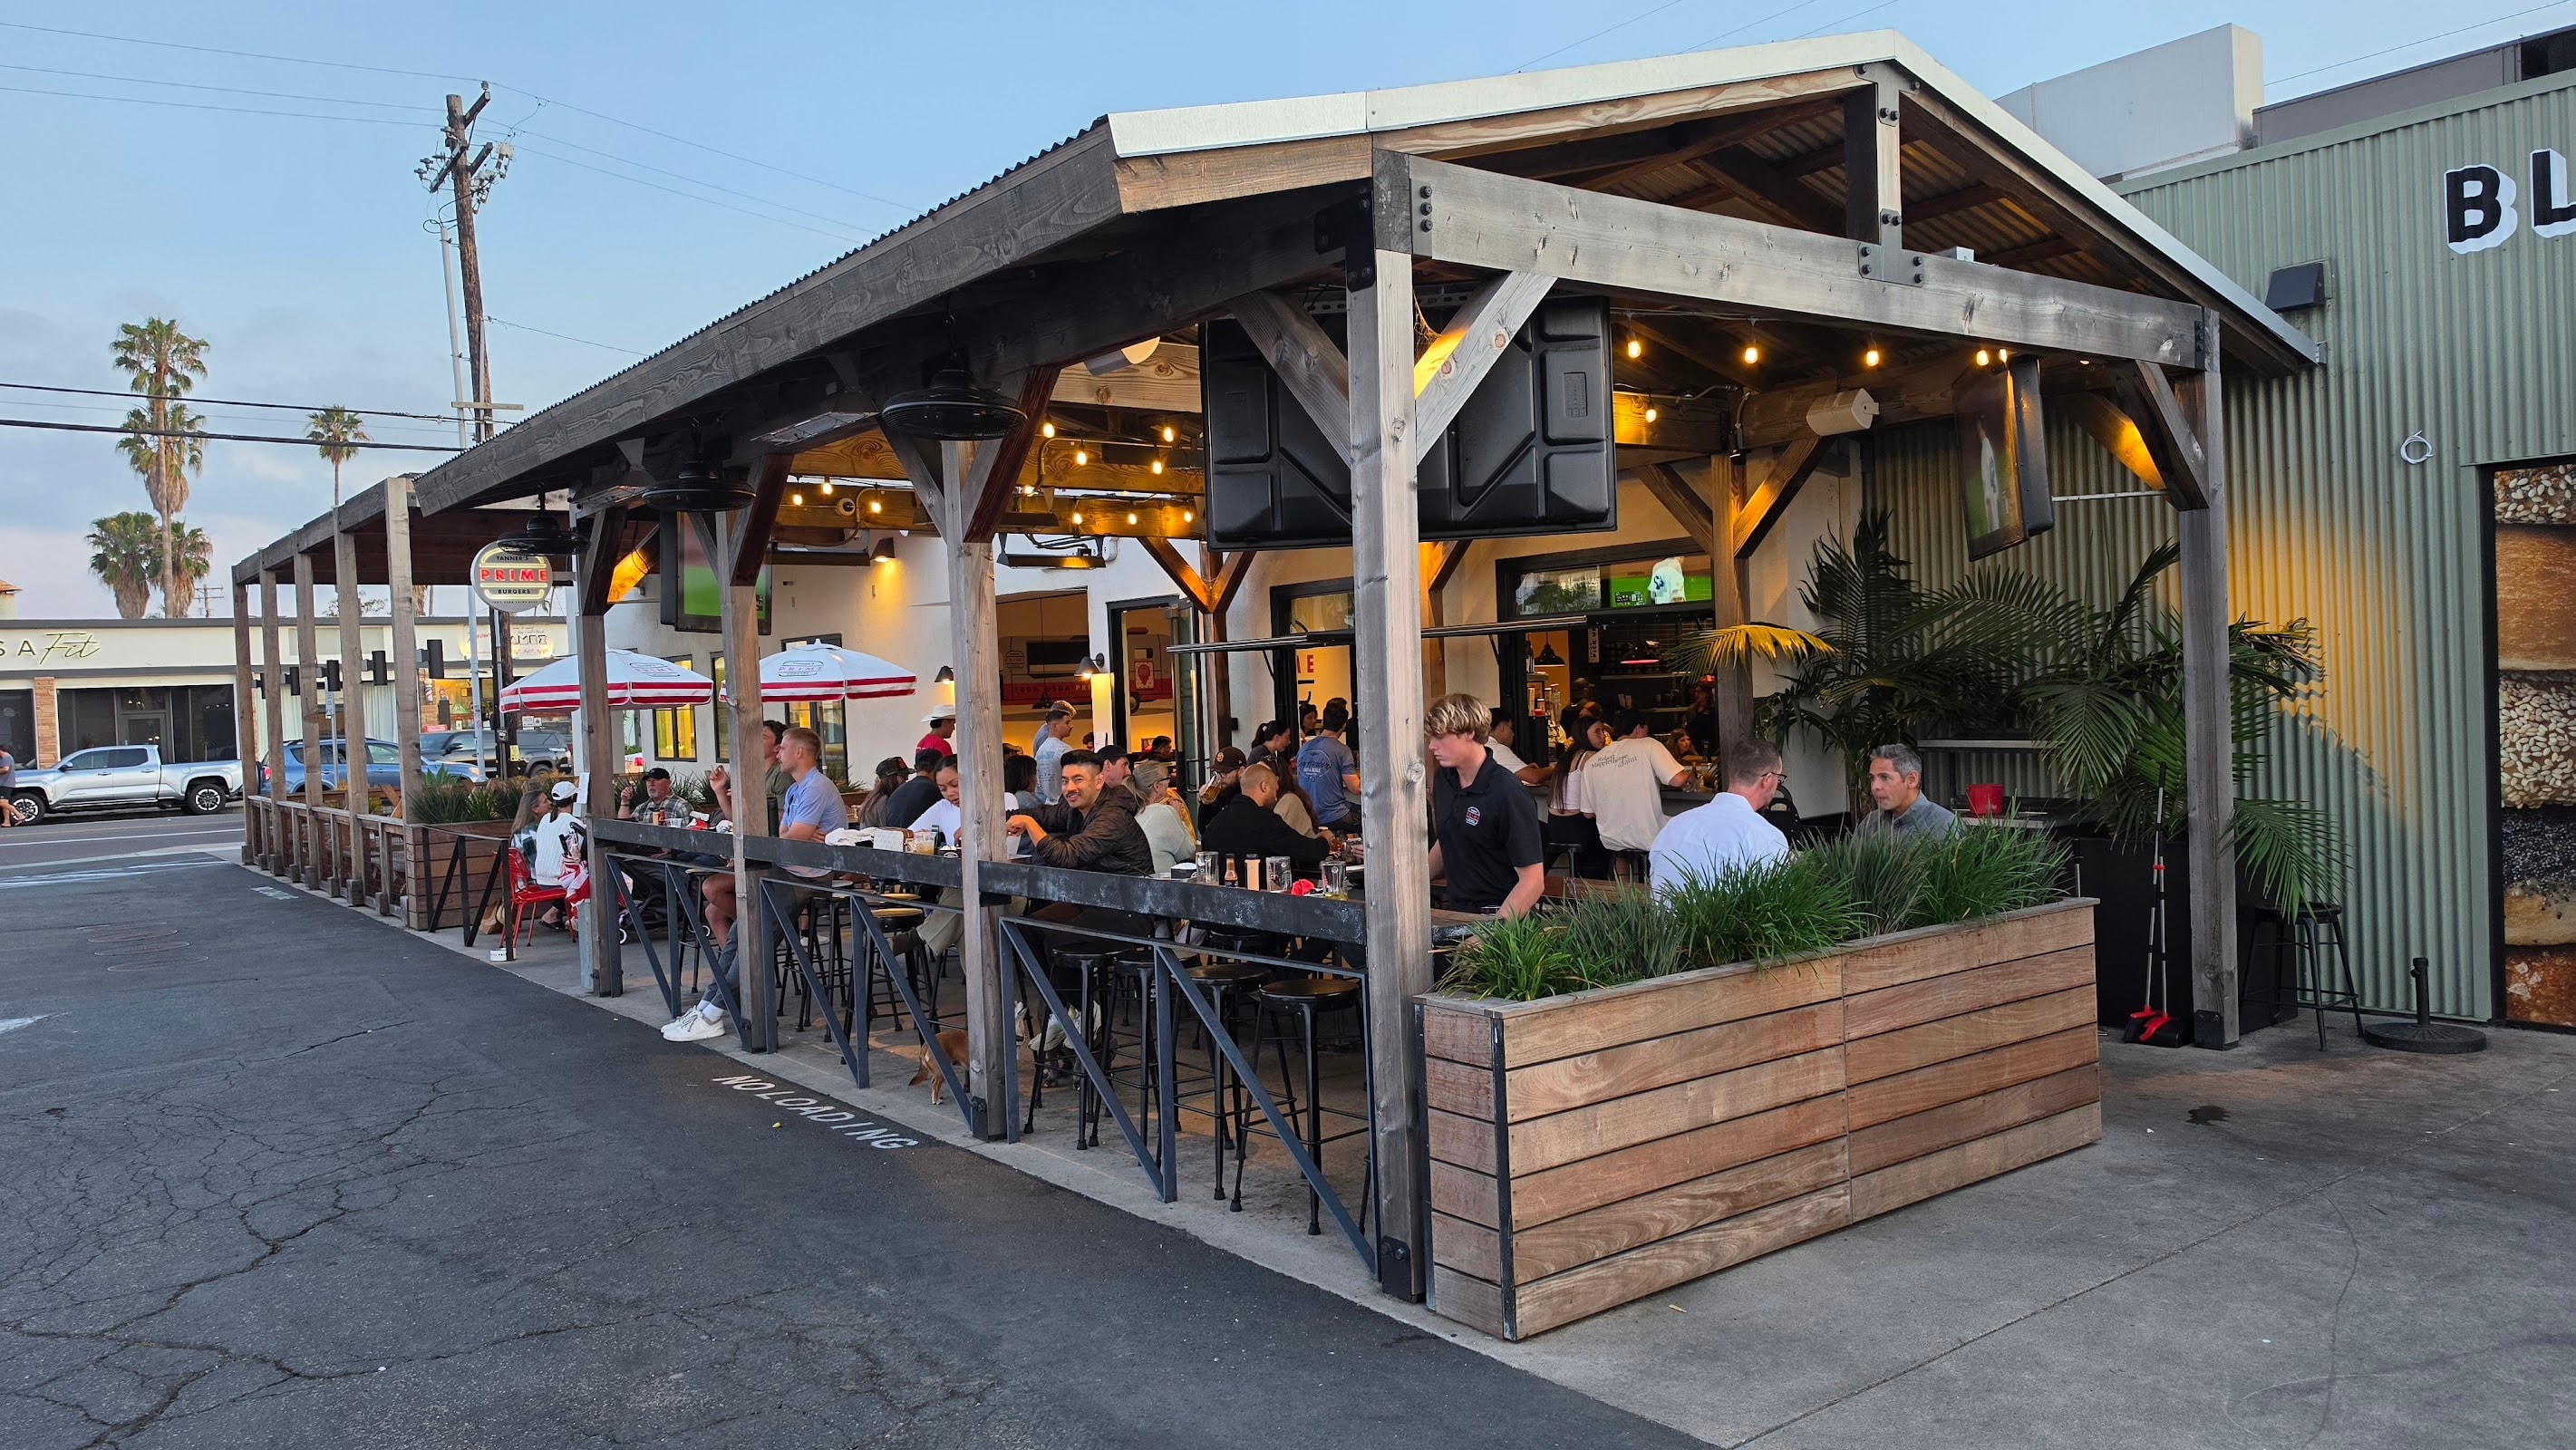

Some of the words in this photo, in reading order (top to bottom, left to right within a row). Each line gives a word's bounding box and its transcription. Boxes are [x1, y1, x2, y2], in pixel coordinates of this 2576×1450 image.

[2444, 149, 2576, 255] BL
[479, 568, 547, 582] PRIME
[39, 632, 101, 665] Fit
[1045, 685, 1070, 693] USDA
[711, 1075, 776, 1091] NO
[754, 1090, 919, 1149] LOADING
